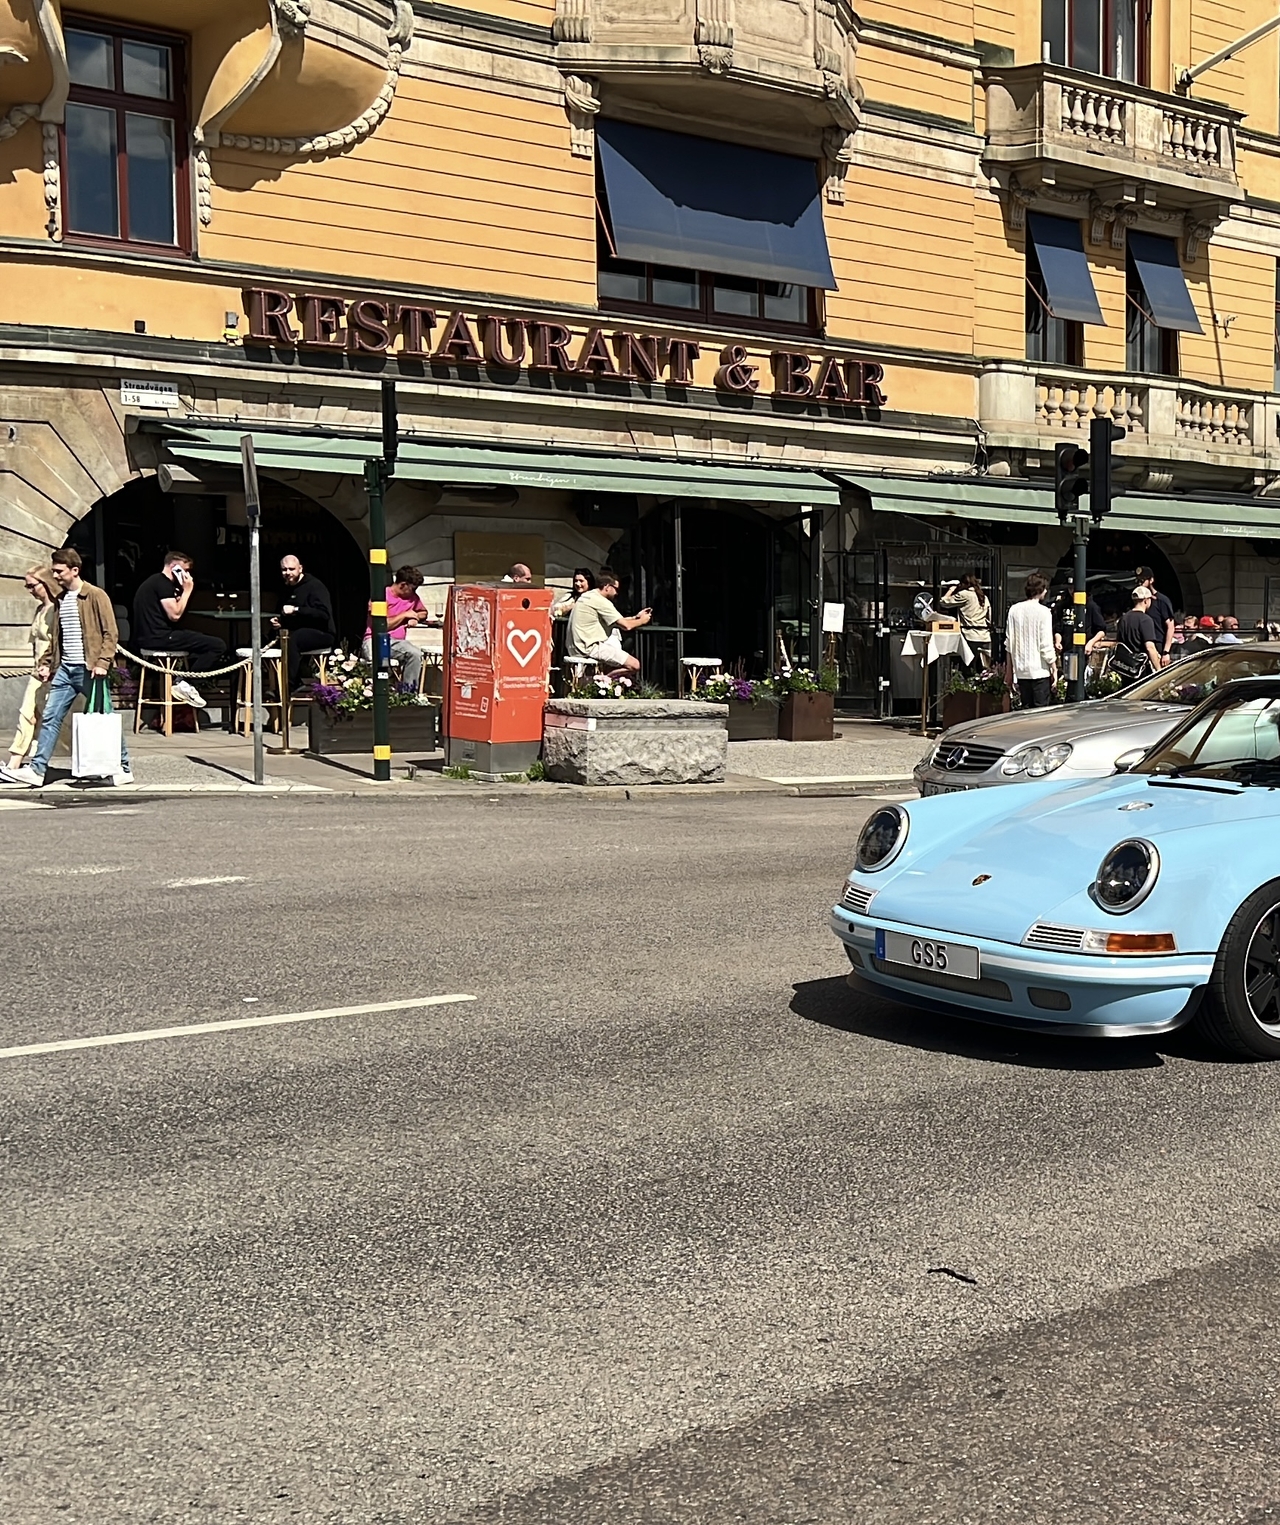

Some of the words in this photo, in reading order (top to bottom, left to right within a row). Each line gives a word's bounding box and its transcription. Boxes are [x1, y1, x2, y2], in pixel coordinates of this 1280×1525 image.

[244, 287, 700, 386] RESTAURANT
[713, 345, 760, 391] &
[771, 350, 888, 406] BAR
[124, 381, 173, 393] Strandvägen
[911, 940, 948, 970] GS5
